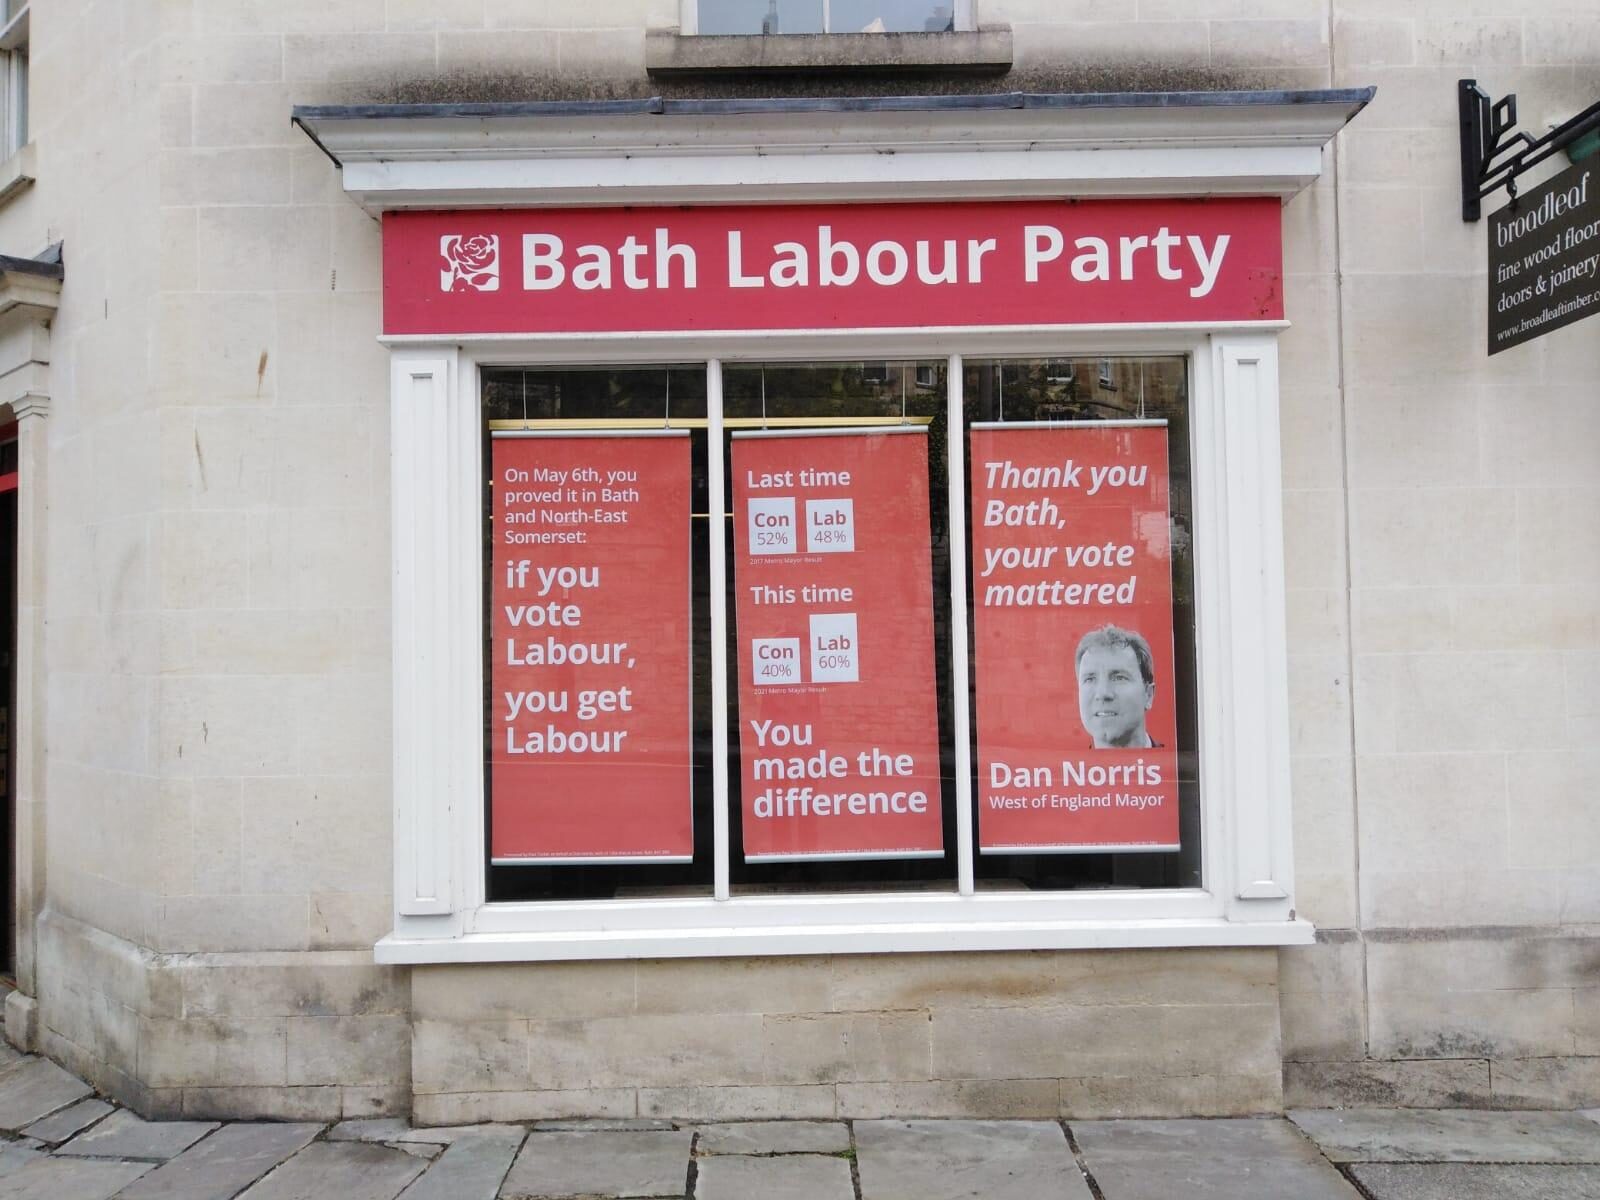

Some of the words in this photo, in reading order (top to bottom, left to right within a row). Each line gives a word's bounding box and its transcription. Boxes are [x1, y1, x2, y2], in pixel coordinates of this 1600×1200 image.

[1497, 172, 1590, 247] broadleaf
[522, 229, 698, 291] Bath
[728, 227, 997, 289] Labour
[1023, 225, 1231, 298] Party
[1497, 262, 1520, 283] fine
[1524, 235, 1561, 269] wood
[1497, 286, 1532, 312] doors
[1535, 275, 1547, 295] &
[1549, 254, 1599, 296] joinery
[504, 468, 528, 482] On
[534, 468, 568, 486] May
[572, 467, 602, 485] 6th,
[607, 470, 637, 485] you
[748, 470, 794, 488] Last
[799, 468, 850, 488] time
[984, 460, 1082, 488] Thank
[1087, 464, 1147, 496] you
[505, 489, 562, 507] proved
[567, 489, 577, 502] it
[582, 489, 598, 502] in
[601, 488, 639, 502] Bath
[505, 508, 536, 523] and
[541, 508, 627, 523] North-East
[754, 512, 789, 527] Con
[813, 510, 846, 526] Lab
[984, 498, 1066, 529] Bath,
[504, 530, 587, 544] Somerset:
[757, 531, 788, 545] 52%
[815, 529, 846, 544] 48%
[981, 547, 1058, 577] your
[1066, 542, 1135, 567] vote
[507, 560, 530, 588] if
[537, 565, 599, 597] you
[984, 576, 1136, 606] mattered
[750, 585, 796, 604] This
[802, 584, 853, 603] time
[505, 601, 581, 627] vote
[507, 637, 636, 669] Labour,
[758, 645, 794, 660] Con
[818, 635, 850, 651] Lab
[761, 663, 792, 678] 40%
[819, 654, 850, 669] 60%
[505, 690, 568, 721] you
[577, 686, 632, 720] get
[507, 725, 627, 754] Labour
[751, 720, 813, 747] You
[754, 749, 848, 780] made
[857, 748, 914, 776] the
[991, 761, 1053, 788] Dan
[1063, 759, 1162, 787] Norris
[753, 788, 927, 817] difference
[990, 795, 1028, 809] West
[1032, 794, 1047, 808] of
[1051, 794, 1111, 810] England
[1115, 793, 1164, 810] Mayor
